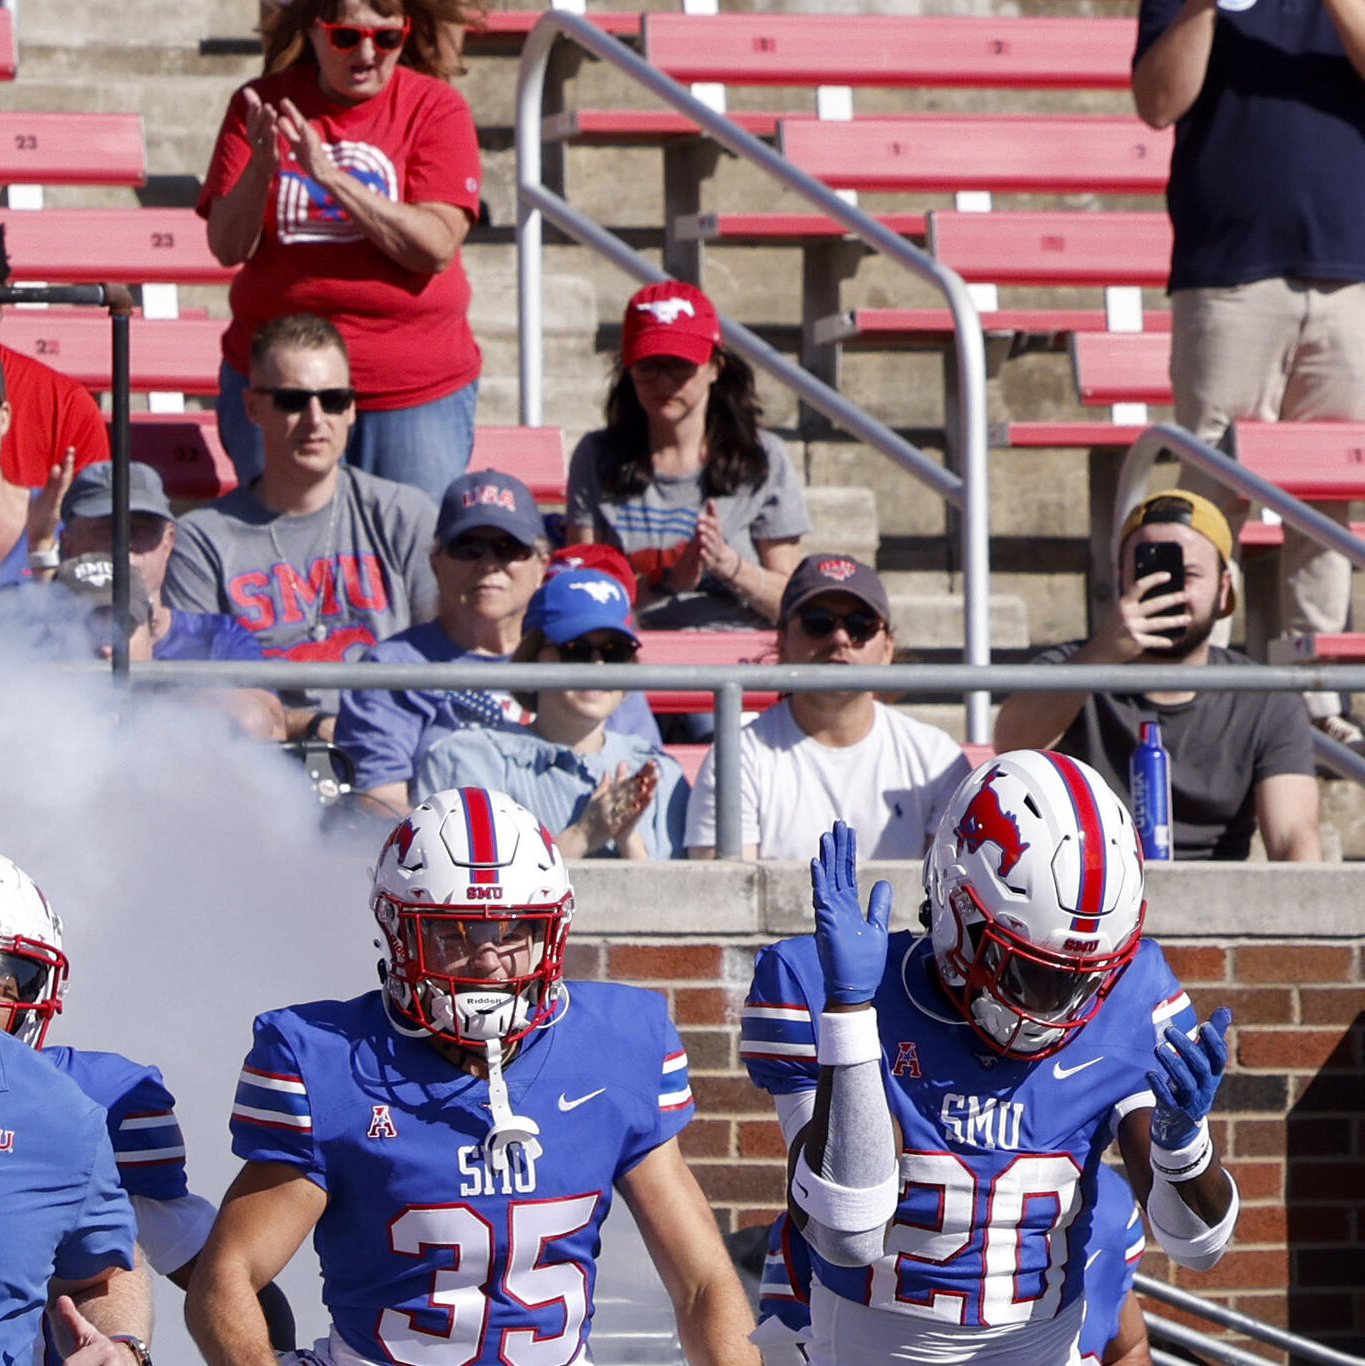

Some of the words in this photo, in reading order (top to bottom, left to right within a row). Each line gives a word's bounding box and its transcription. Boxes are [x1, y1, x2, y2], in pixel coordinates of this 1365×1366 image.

[14, 134, 38, 151] 23
[149, 232, 175, 249] 23
[229, 553, 387, 632] SMU
[466, 885, 504, 901] SMU
[1062, 938, 1101, 953] SMU
[466, 995, 503, 1006] Riddell
[938, 1092, 1024, 1151] SMU
[458, 1143, 537, 1197] SMU
[868, 1151, 1085, 1327] 20
